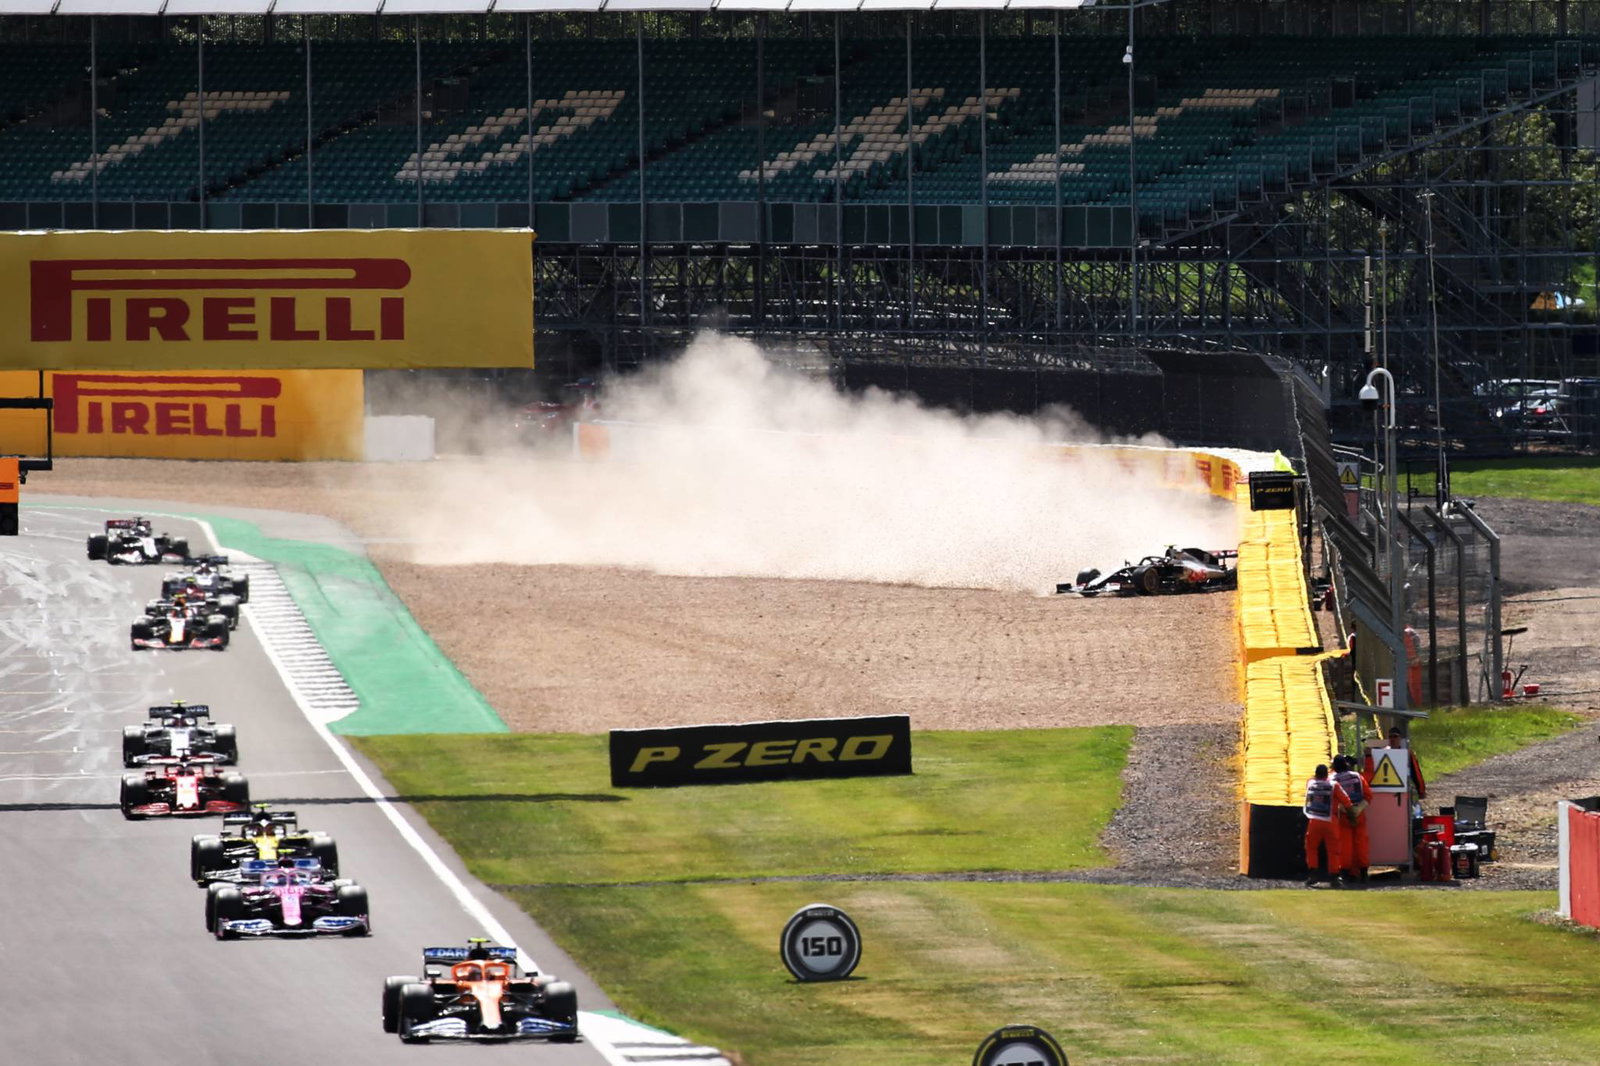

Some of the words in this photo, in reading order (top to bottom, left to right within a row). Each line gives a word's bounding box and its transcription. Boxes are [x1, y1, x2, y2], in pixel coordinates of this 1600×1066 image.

[30, 258, 411, 341] PIRELLI
[53, 373, 281, 437] PIRELLI
[1378, 682, 1390, 706] F
[628, 746, 680, 772] P
[694, 734, 894, 769] ZERO
[802, 935, 842, 956] 150
